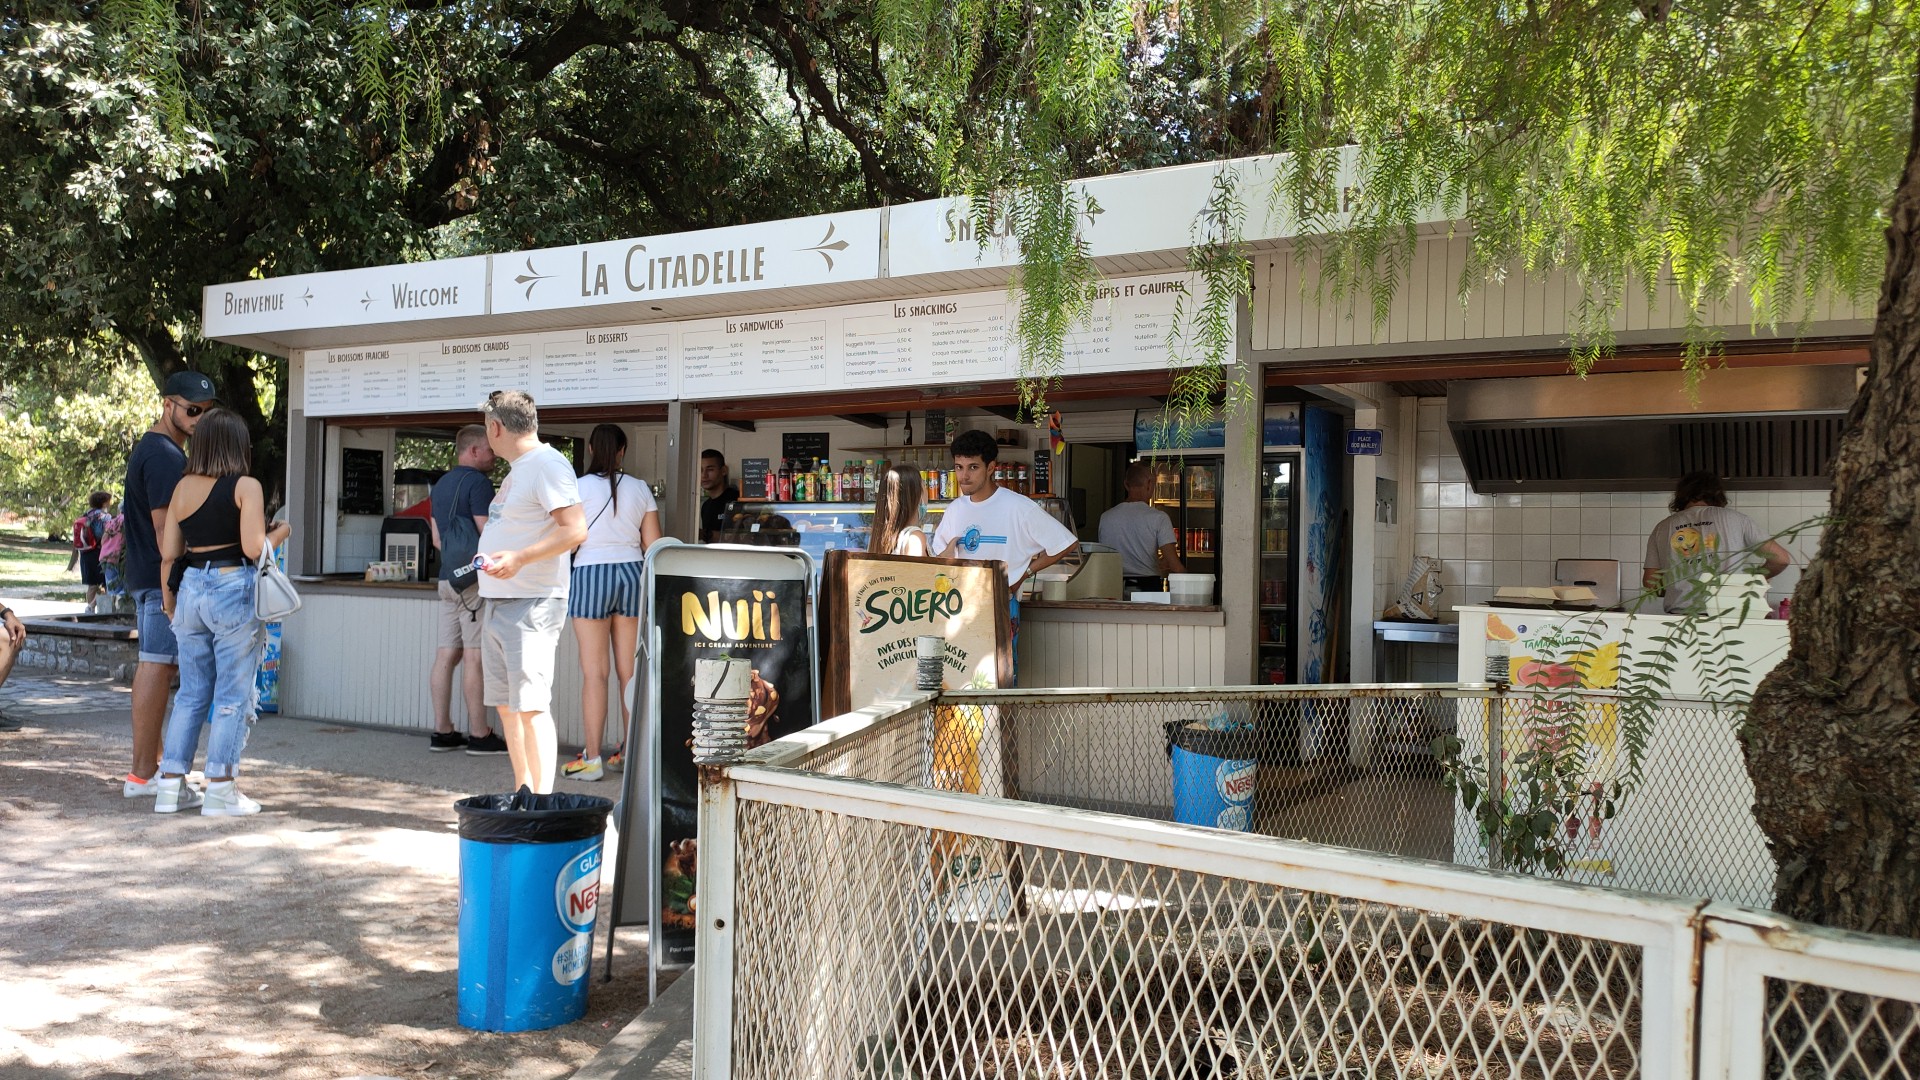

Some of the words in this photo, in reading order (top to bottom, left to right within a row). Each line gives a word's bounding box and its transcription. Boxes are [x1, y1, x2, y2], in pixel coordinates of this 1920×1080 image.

[945, 208, 1017, 243] SNCK
[581, 251, 609, 297] LA
[624, 244, 765, 292] CITADELLE
[392, 282, 459, 310] WELCOME
[1125, 285, 1135, 297] ET
[1139, 281, 1184, 295] GAUFRES
[224, 291, 284, 316] BIENVENUE
[894, 303, 906, 318] LES
[910, 303, 957, 317] SNACKINGS
[726, 320, 737, 334] LES
[740, 319, 784, 332] SANDWICHS
[1134, 322, 1158, 330] Chantilly
[586, 331, 596, 345] LES
[598, 332, 628, 344] DESSERTS
[442, 342, 450, 355] LES
[453, 344, 481, 354] BOISSONS
[484, 341, 510, 351] CHAUDES
[328, 351, 336, 363] LES
[337, 353, 363, 363] BOISSONS
[365, 350, 390, 360] FRAICHES
[860, 588, 963, 634] SOLERO
[877, 642, 896, 657] AVEC
[897, 637, 912, 649] DES
[958, 649, 969, 661] DE
